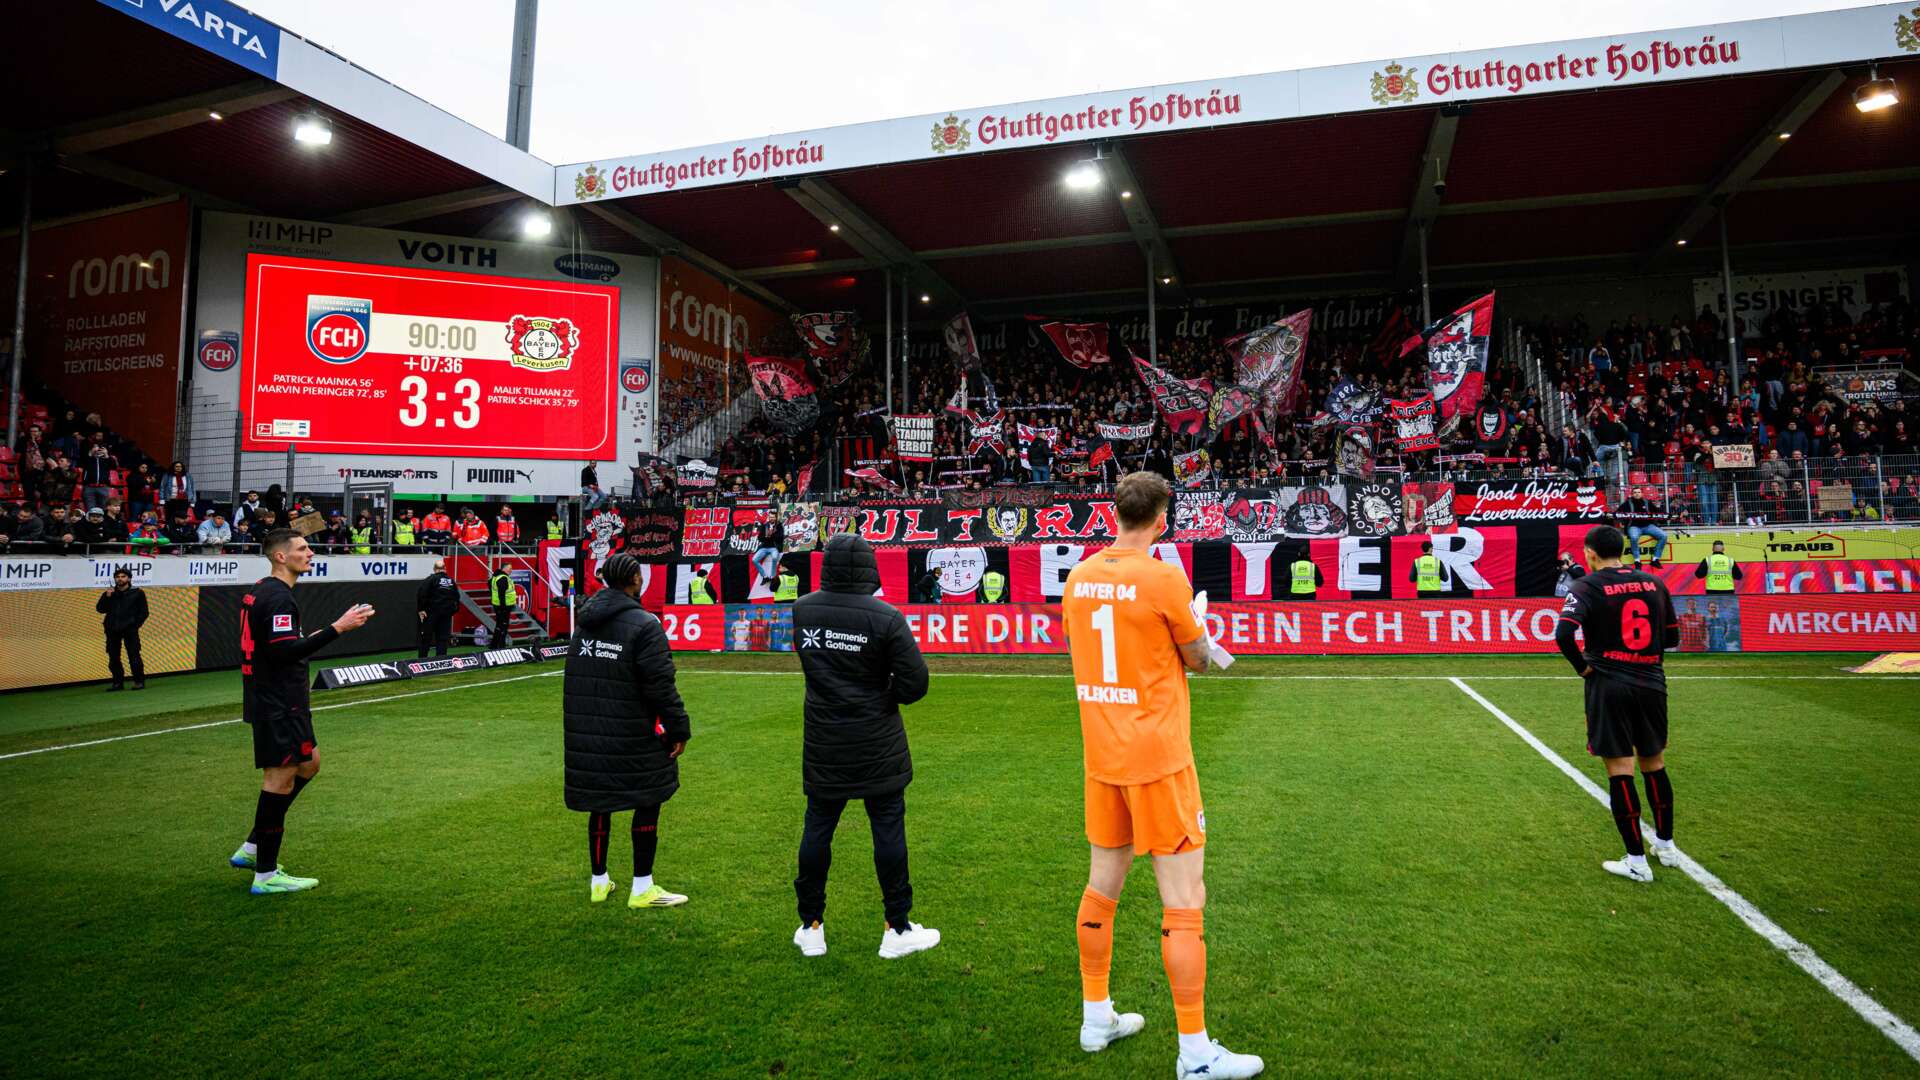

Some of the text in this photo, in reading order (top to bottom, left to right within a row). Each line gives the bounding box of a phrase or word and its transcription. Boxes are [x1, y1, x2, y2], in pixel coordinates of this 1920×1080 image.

[160, 0, 267, 59] VARTA
[1426, 36, 1741, 96] Stuttgarter Hofbräu
[978, 89, 1240, 144] Stuttgarter Hofbräu
[612, 140, 824, 191] Stuttgarter Hofbräu
[277, 223, 333, 244] MHP
[398, 239, 496, 267] VOITH
[67, 249, 171, 299] roma
[670, 291, 749, 353] roma
[64, 333, 146, 352] RAFFSTOREN
[319, 327, 358, 347] FCH
[408, 322, 477, 351] 90:00
[64, 353, 164, 374] TEXTILSCREENS
[206, 350, 231, 362] FCH
[403, 356, 463, 373] +07:36
[517, 357, 564, 367] Leverkusen
[273, 374, 314, 385] PATRICK
[315, 376, 357, 387] MAINKA
[626, 374, 645, 386] FCH
[257, 384, 301, 394] MARVIN
[302, 386, 354, 397] PIERINGER
[493, 385, 522, 394] MALIK
[523, 387, 561, 397] TILLMAN
[487, 395, 517, 404] PATRIK
[518, 397, 551, 406] SCHICK
[467, 469, 515, 483] PUMA
[1350, 485, 1391, 534] COMMANDO
[1465, 507, 1568, 521] Leverkusen
[1767, 543, 1834, 552] TRAUB
[6, 563, 52, 578] MHP
[206, 562, 237, 574] MHP
[361, 562, 408, 575] VOITH
[940, 560, 976, 569] BAYER
[1073, 582, 1137, 601] BAYER 04
[1603, 582, 1642, 595] BAYER
[985, 613, 1052, 643] DIR
[1322, 611, 1403, 643] FCH
[1621, 598, 1652, 650] 6
[1768, 611, 1918, 634] MERCHAN
[825, 629, 868, 643] Barmenia
[1091, 603, 1119, 683] 1
[825, 640, 862, 652] Gothaer
[484, 648, 524, 666] PUMA
[331, 664, 386, 685] PUMA
[1076, 684, 1138, 704] FLEKKEN
